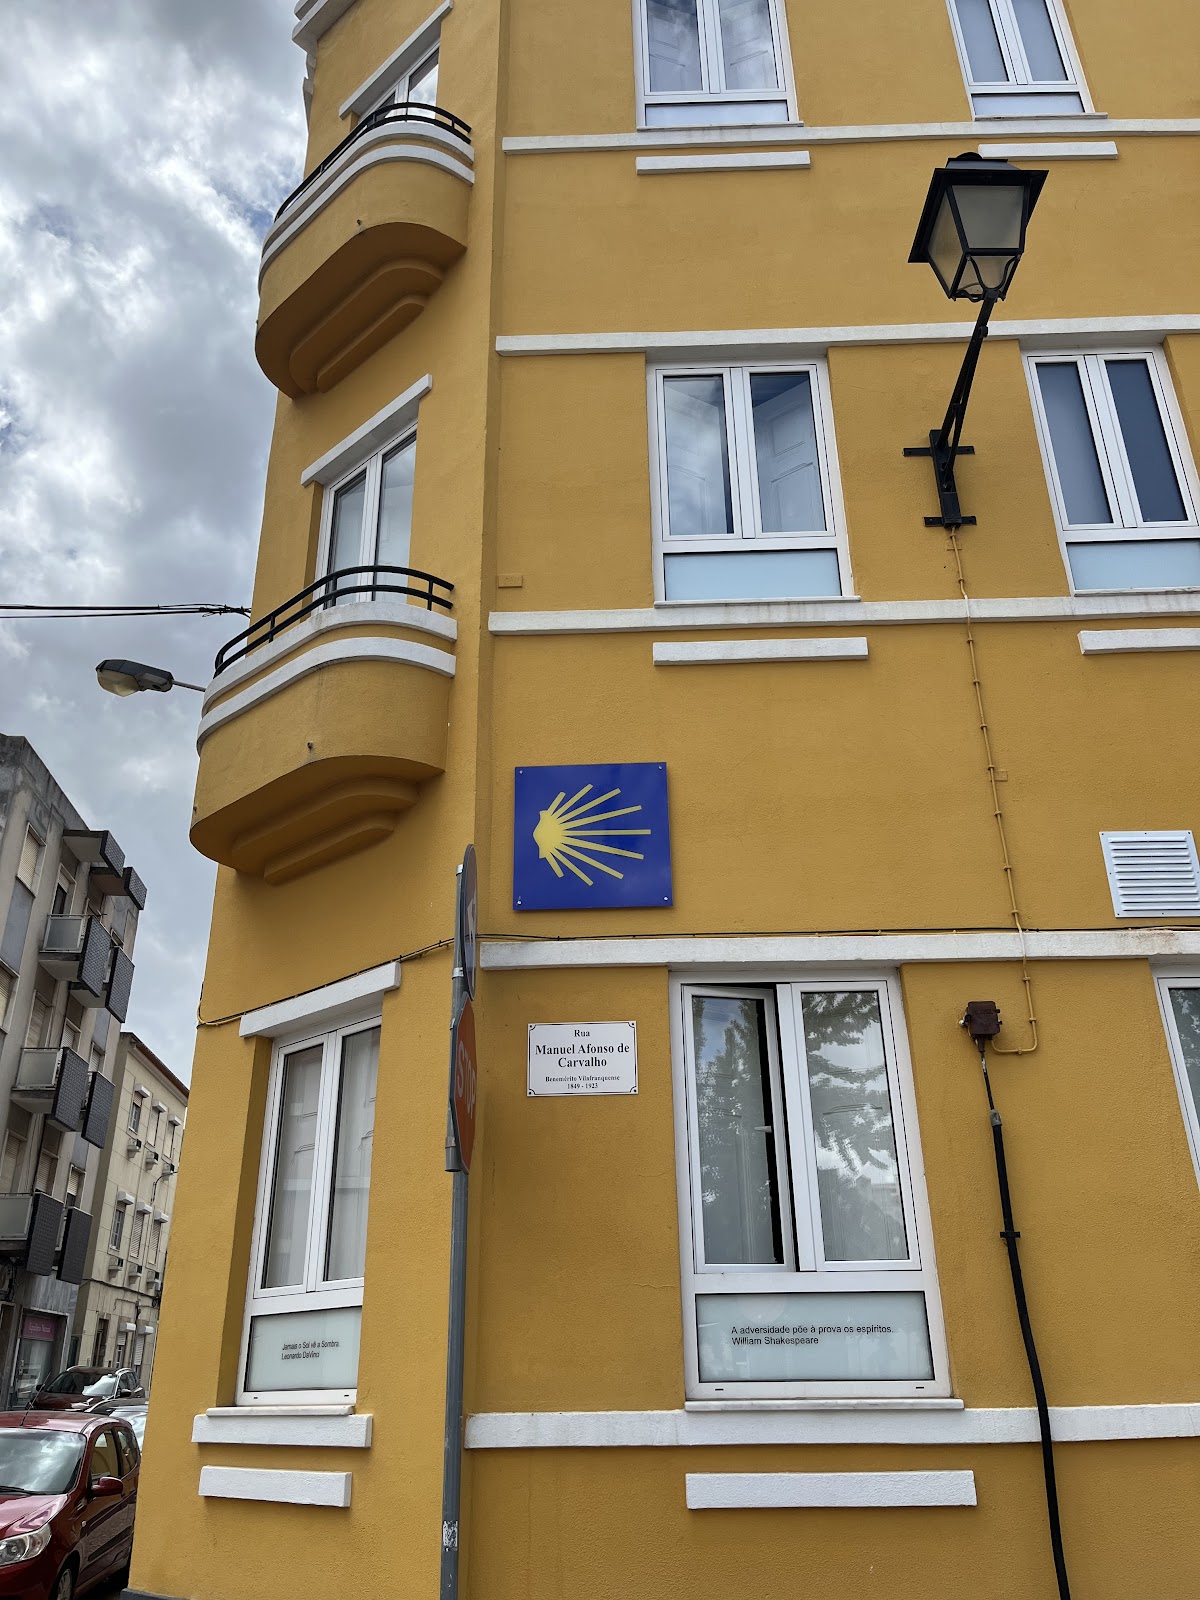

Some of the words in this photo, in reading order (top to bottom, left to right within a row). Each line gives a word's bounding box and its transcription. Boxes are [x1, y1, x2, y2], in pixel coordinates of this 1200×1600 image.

[574, 1029, 590, 1037] Rua
[535, 1044, 575, 1055] Manuel
[578, 1043, 614, 1054] Afonso
[617, 1043, 630, 1053] de
[558, 1057, 607, 1068] Carvalho
[457, 1040, 476, 1119] STOP
[731, 1326, 738, 1334] A
[740, 1325, 790, 1334] adversidade
[792, 1325, 808, 1335] põe
[818, 1326, 842, 1335] prova
[731, 1336, 762, 1345] William
[764, 1336, 819, 1346] Shakespeare
[282, 1343, 298, 1351] Jamais
[281, 1352, 302, 1360] Leonardo
